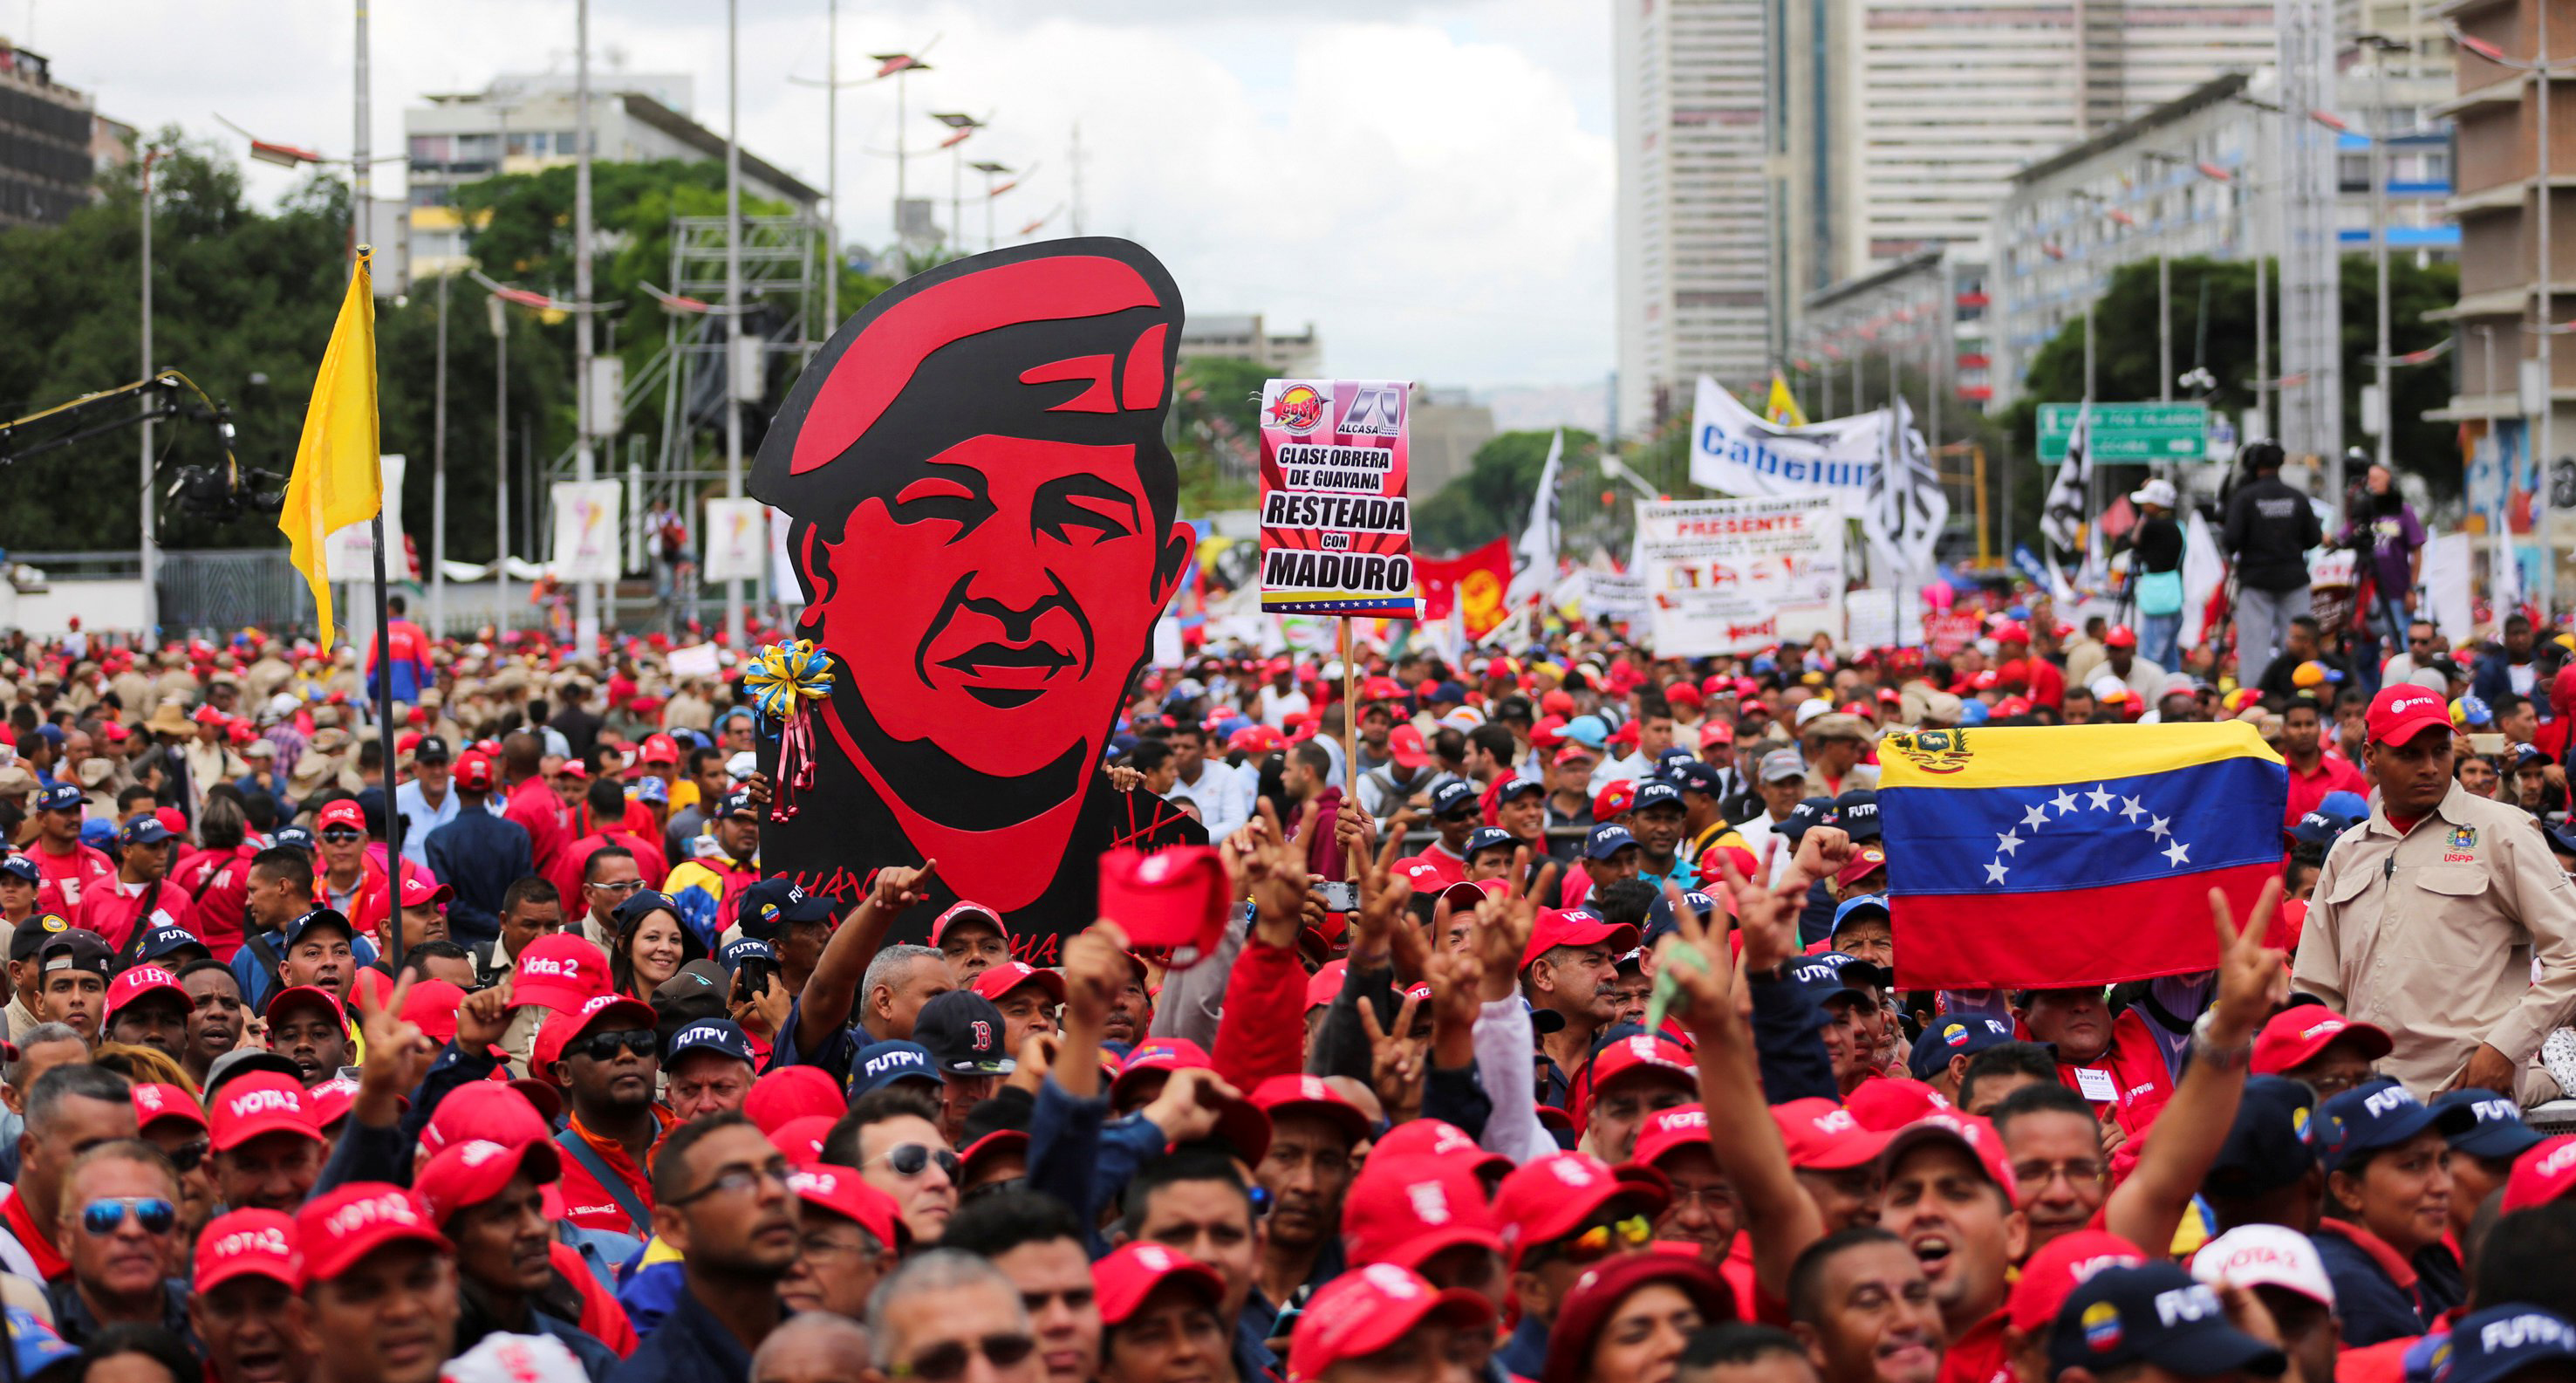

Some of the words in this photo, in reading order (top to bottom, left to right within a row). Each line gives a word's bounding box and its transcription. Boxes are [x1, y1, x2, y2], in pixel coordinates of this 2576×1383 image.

[1337, 423, 1379, 435] ALCASA
[1279, 446, 1328, 466] CLASE
[1329, 448, 1390, 469] OBRERA
[1288, 469, 1310, 485] DE
[1313, 469, 1379, 490] GUAYANA
[1266, 494, 1405, 531] RESTEADA
[1676, 514, 1804, 537] PRESENTE
[1322, 534, 1348, 548] CON
[1266, 551, 1410, 592] MADURO
[2406, 697, 2435, 708] PDVSA
[1848, 803, 1878, 818] FUTP
[2443, 853, 2474, 863] USPP
[728, 941, 769, 959] FUTPV
[523, 955, 561, 976] Vota
[563, 958, 580, 978] 2
[1793, 964, 1837, 982] UTPV
[677, 1025, 728, 1050] FUTPV
[971, 1020, 992, 1051] B
[864, 1051, 925, 1078] FUTPV
